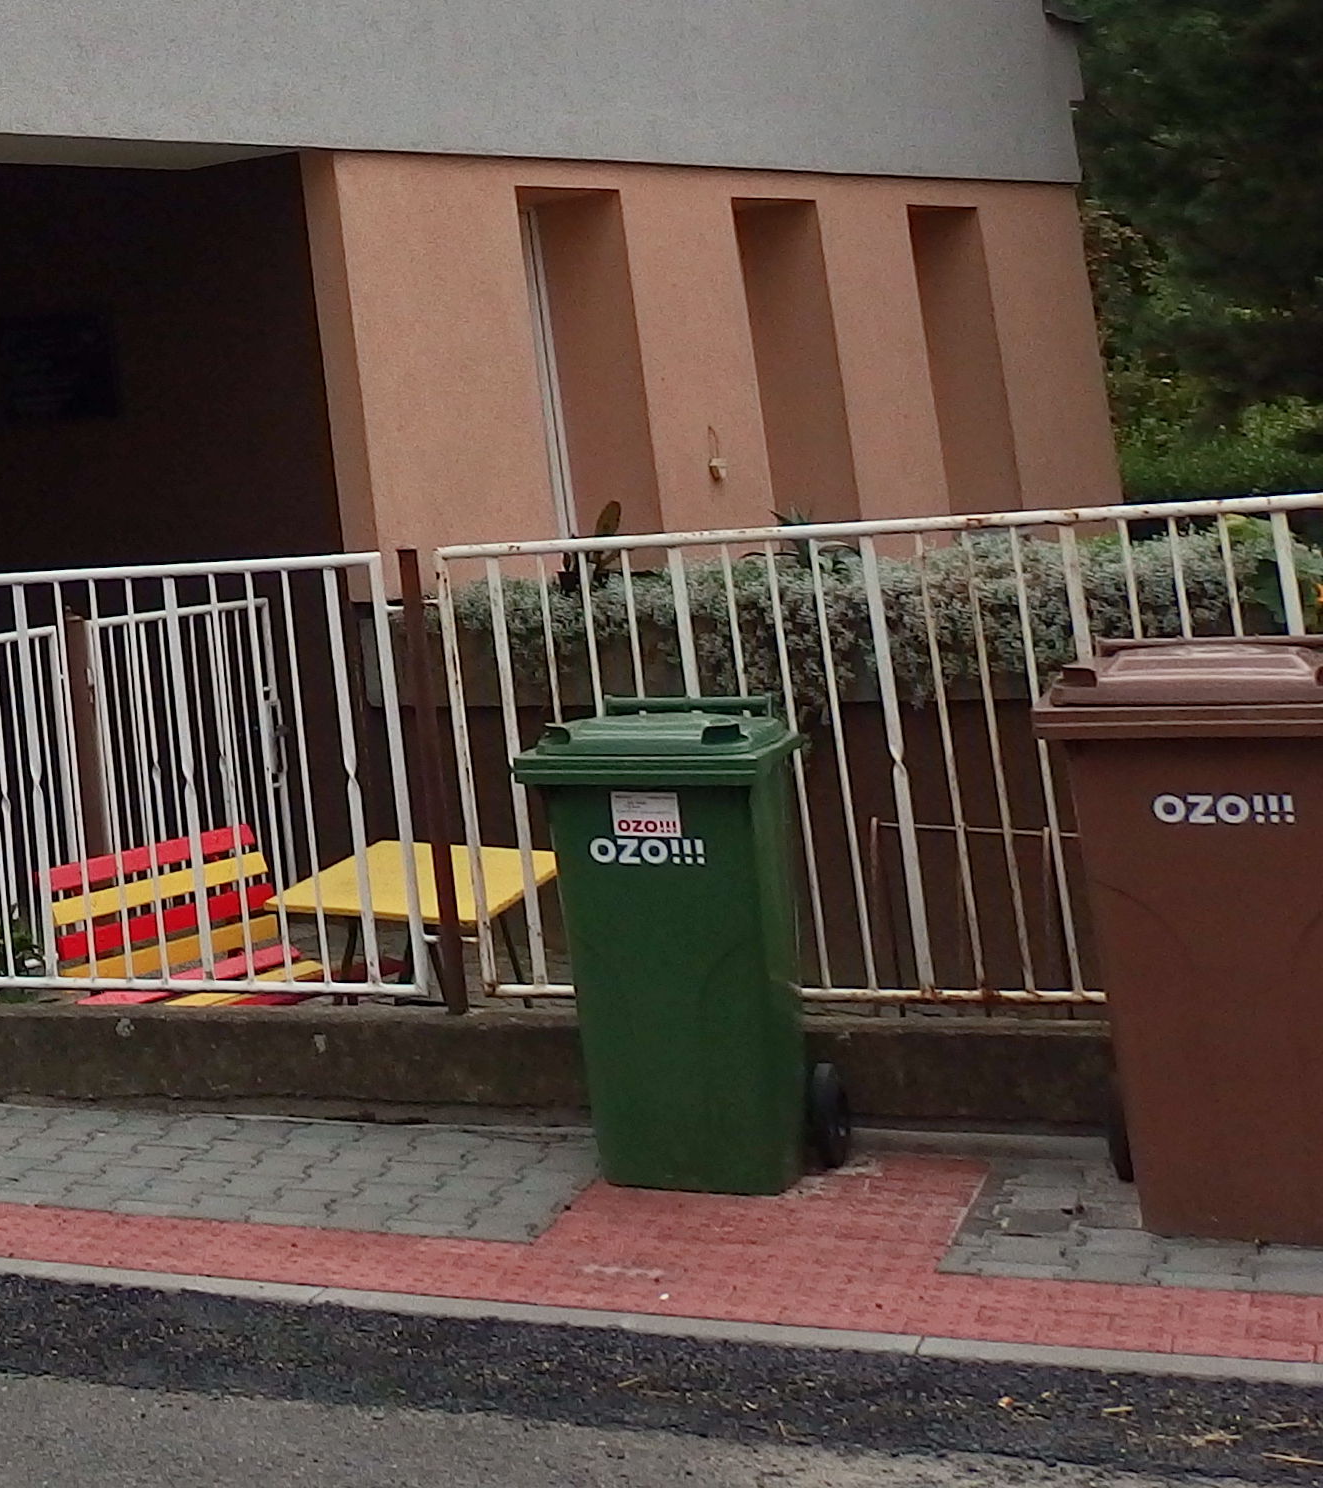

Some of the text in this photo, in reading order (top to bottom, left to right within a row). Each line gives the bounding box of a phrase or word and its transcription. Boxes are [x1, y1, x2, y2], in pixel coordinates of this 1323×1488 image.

[1152, 793, 1295, 825] OZO!!!
[618, 819, 677, 833] OZO!!!
[589, 838, 705, 865] OZO!!!
